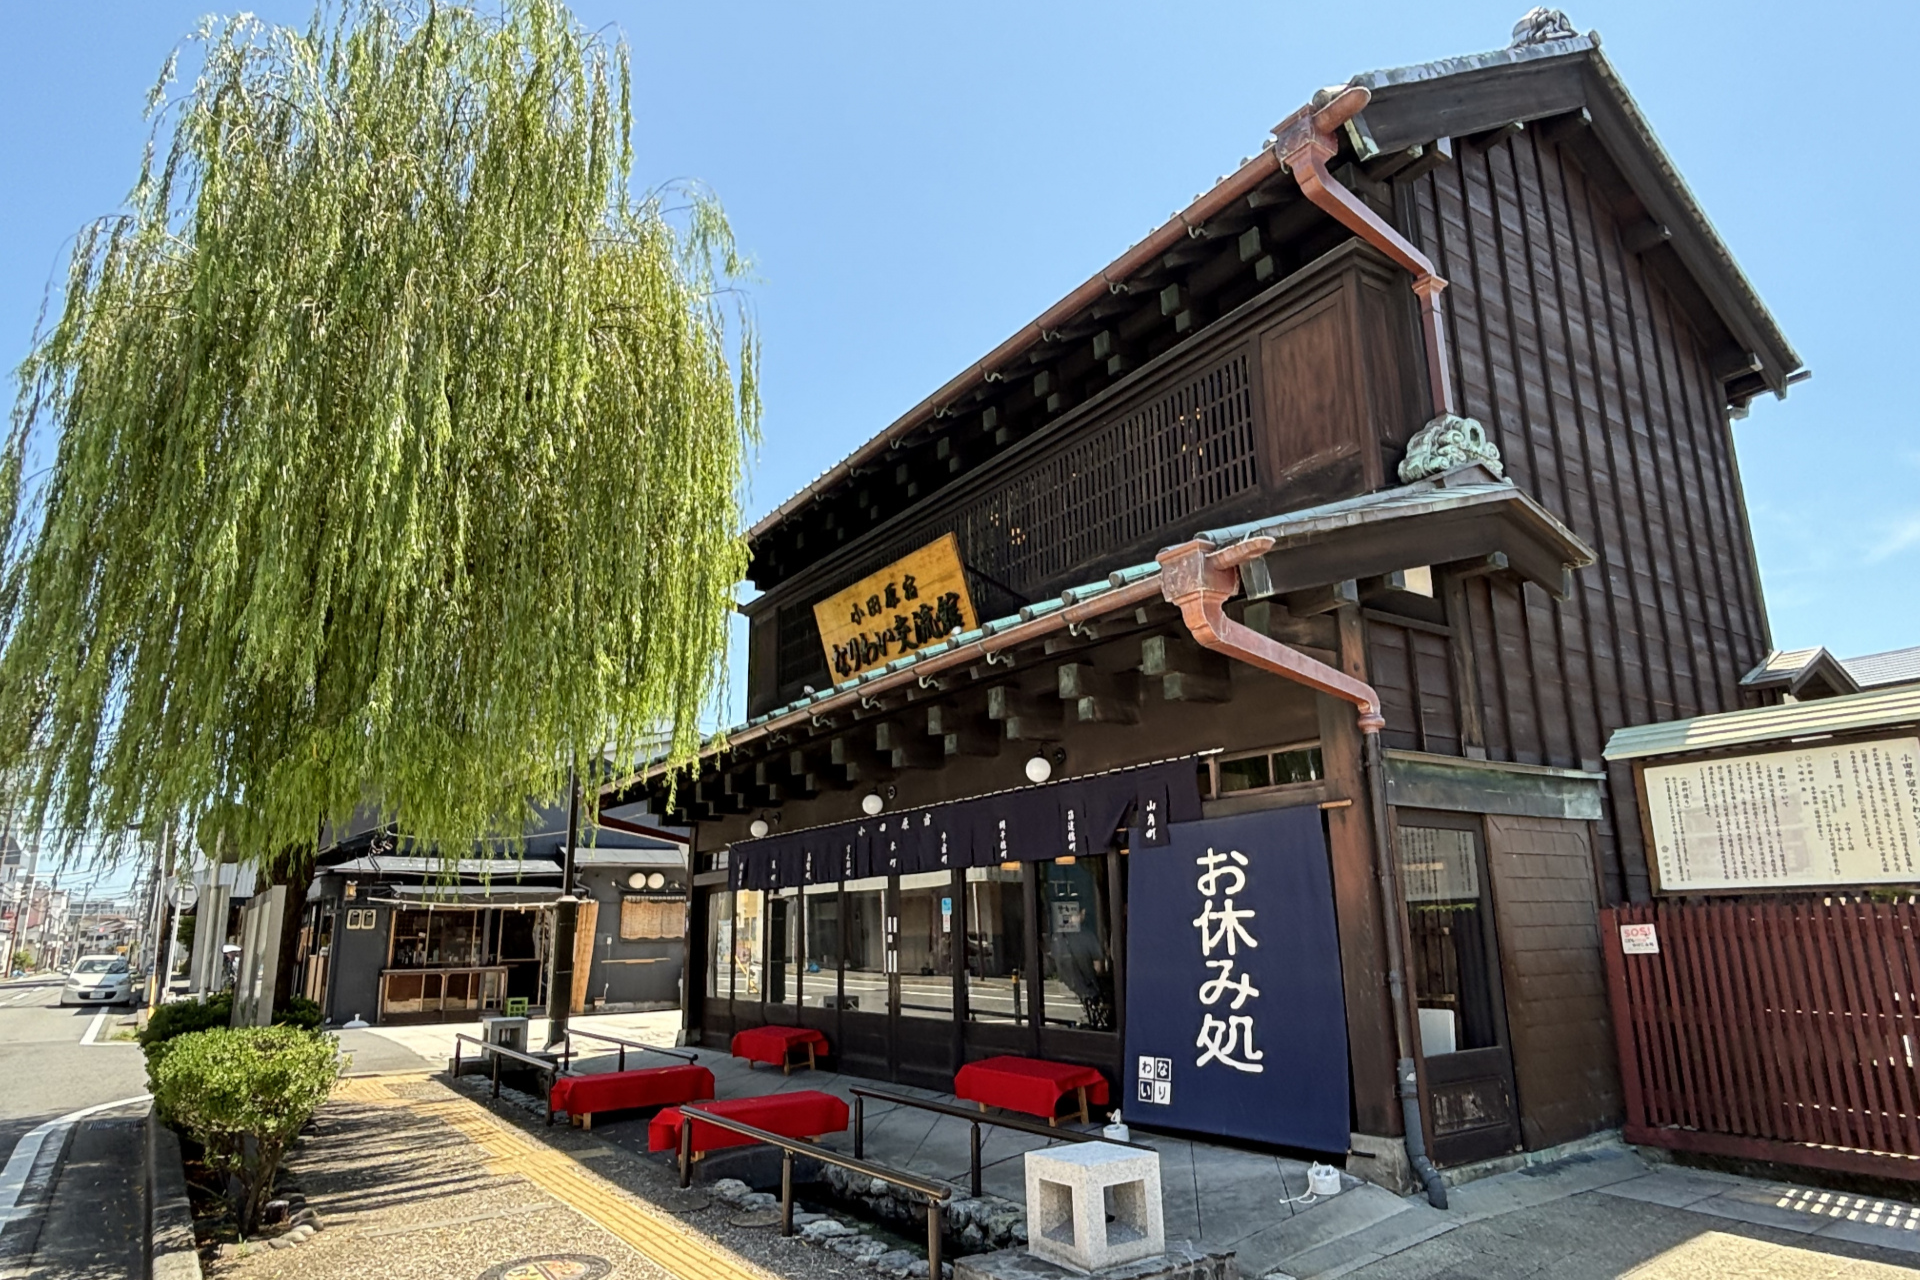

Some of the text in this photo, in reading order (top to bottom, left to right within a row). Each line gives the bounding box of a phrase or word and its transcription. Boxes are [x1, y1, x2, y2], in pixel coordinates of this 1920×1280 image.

[851, 574, 918, 625] 小田原宿
[832, 592, 965, 677] なりわい交流館
[858, 812, 932, 837] 小田原宿
[1145, 800, 1156, 840] 山角町
[889, 841, 897, 868] 本町
[1193, 847, 1264, 1073] お休み処
